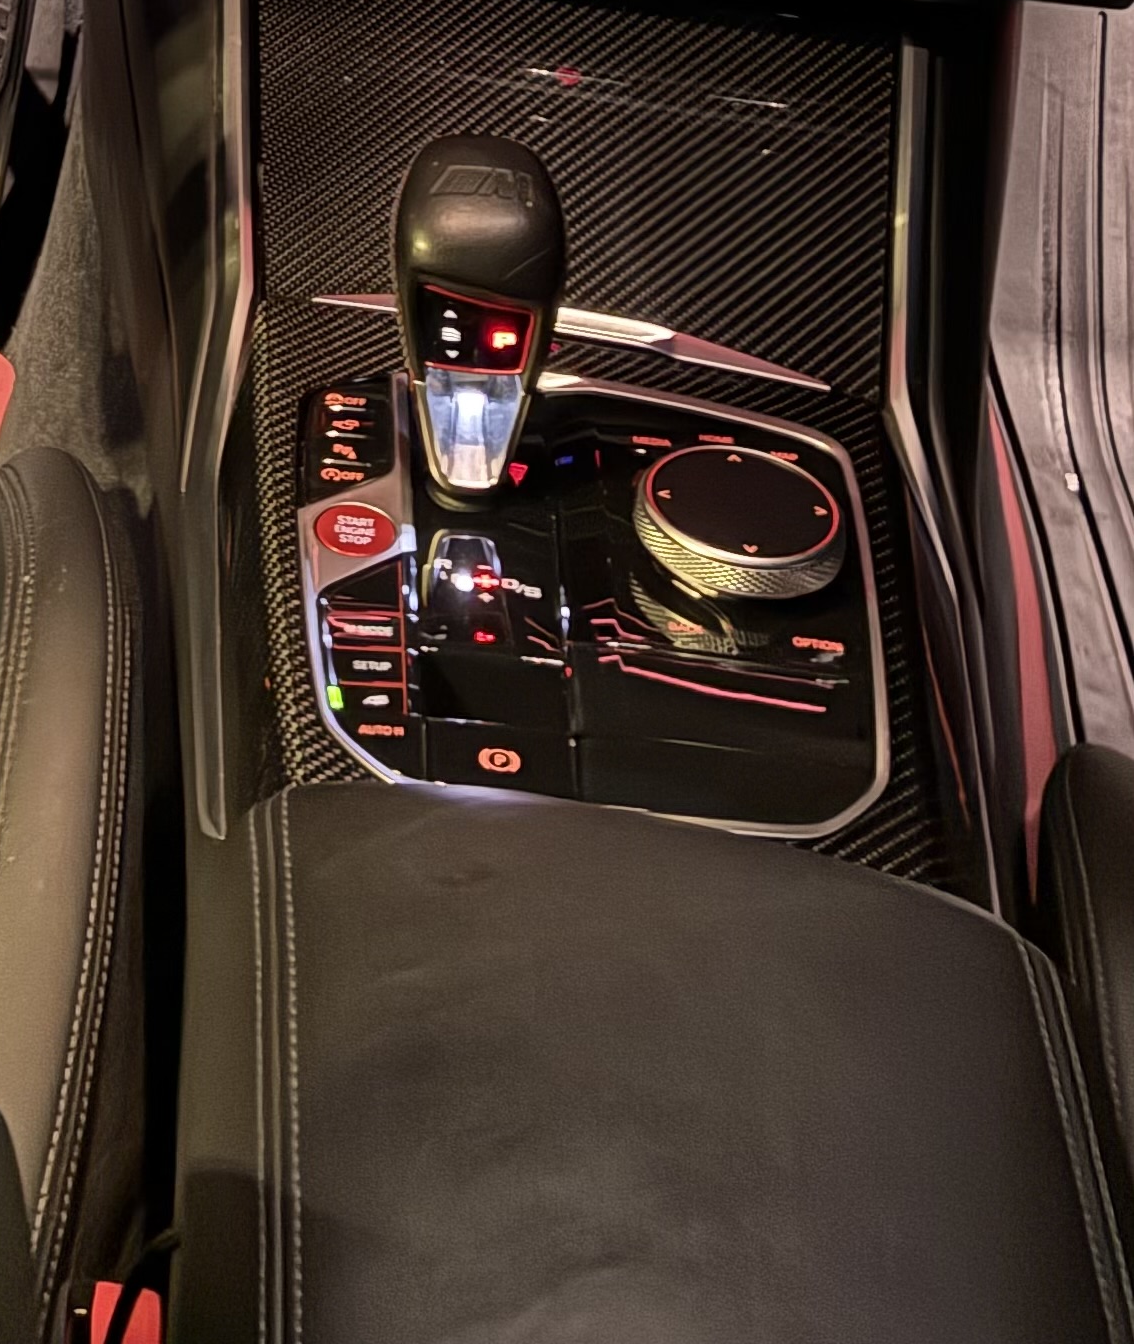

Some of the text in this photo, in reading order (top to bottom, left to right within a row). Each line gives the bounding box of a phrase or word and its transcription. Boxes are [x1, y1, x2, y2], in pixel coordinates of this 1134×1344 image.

[492, 330, 518, 350] P
[698, 433, 735, 445] HOME
[341, 471, 365, 482] OFF
[336, 514, 375, 528] START
[333, 523, 376, 537] ENGINE
[338, 533, 373, 545] STOP
[792, 635, 844, 652] OPTION
[352, 659, 393, 672] SETUP
[357, 723, 393, 736] AUTO
